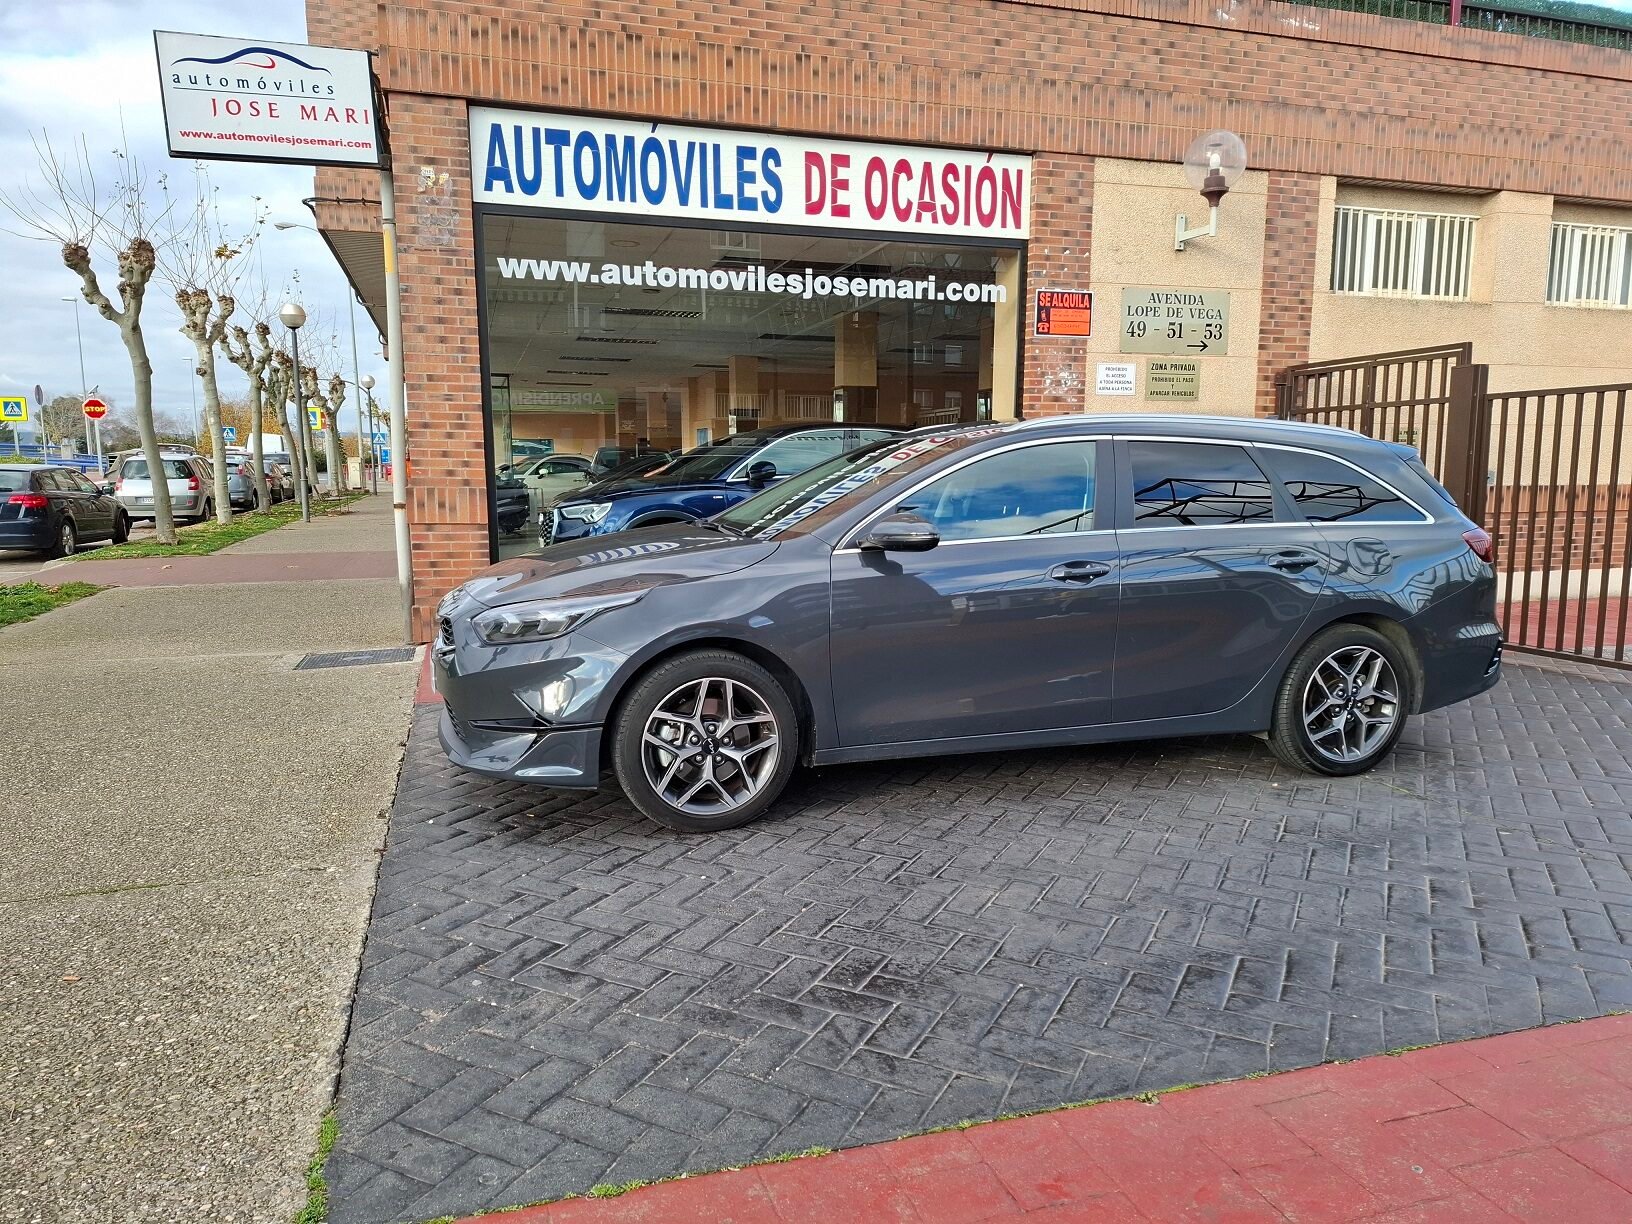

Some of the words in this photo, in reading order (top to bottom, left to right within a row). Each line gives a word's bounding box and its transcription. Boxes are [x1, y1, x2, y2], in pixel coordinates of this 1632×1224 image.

[172, 73, 334, 95] automóviles
[211, 98, 280, 118] JOSE
[300, 104, 370, 124] MARI
[180, 130, 372, 149] www.automovilesjosemari.com
[483, 122, 783, 214] AUTOMÓVILES
[804, 151, 851, 218] DE
[864, 152, 1023, 230] OCASIÓN
[497, 257, 1007, 303] www.automovilesjosemari.com
[1039, 292, 1051, 307] SE
[1052, 293, 1090, 308] ALQUILA
[1148, 292, 1205, 306] AVENIDA
[1127, 305, 1161, 318] LOPE
[1166, 307, 1184, 319] DE
[1189, 308, 1223, 320] VEGA
[1126, 321, 1147, 338] 49
[1167, 322, 1184, 339] 51
[1204, 323, 1223, 340] 53
[1151, 363, 1168, 371] ZONA
[1170, 363, 1196, 372] PRIVADA
